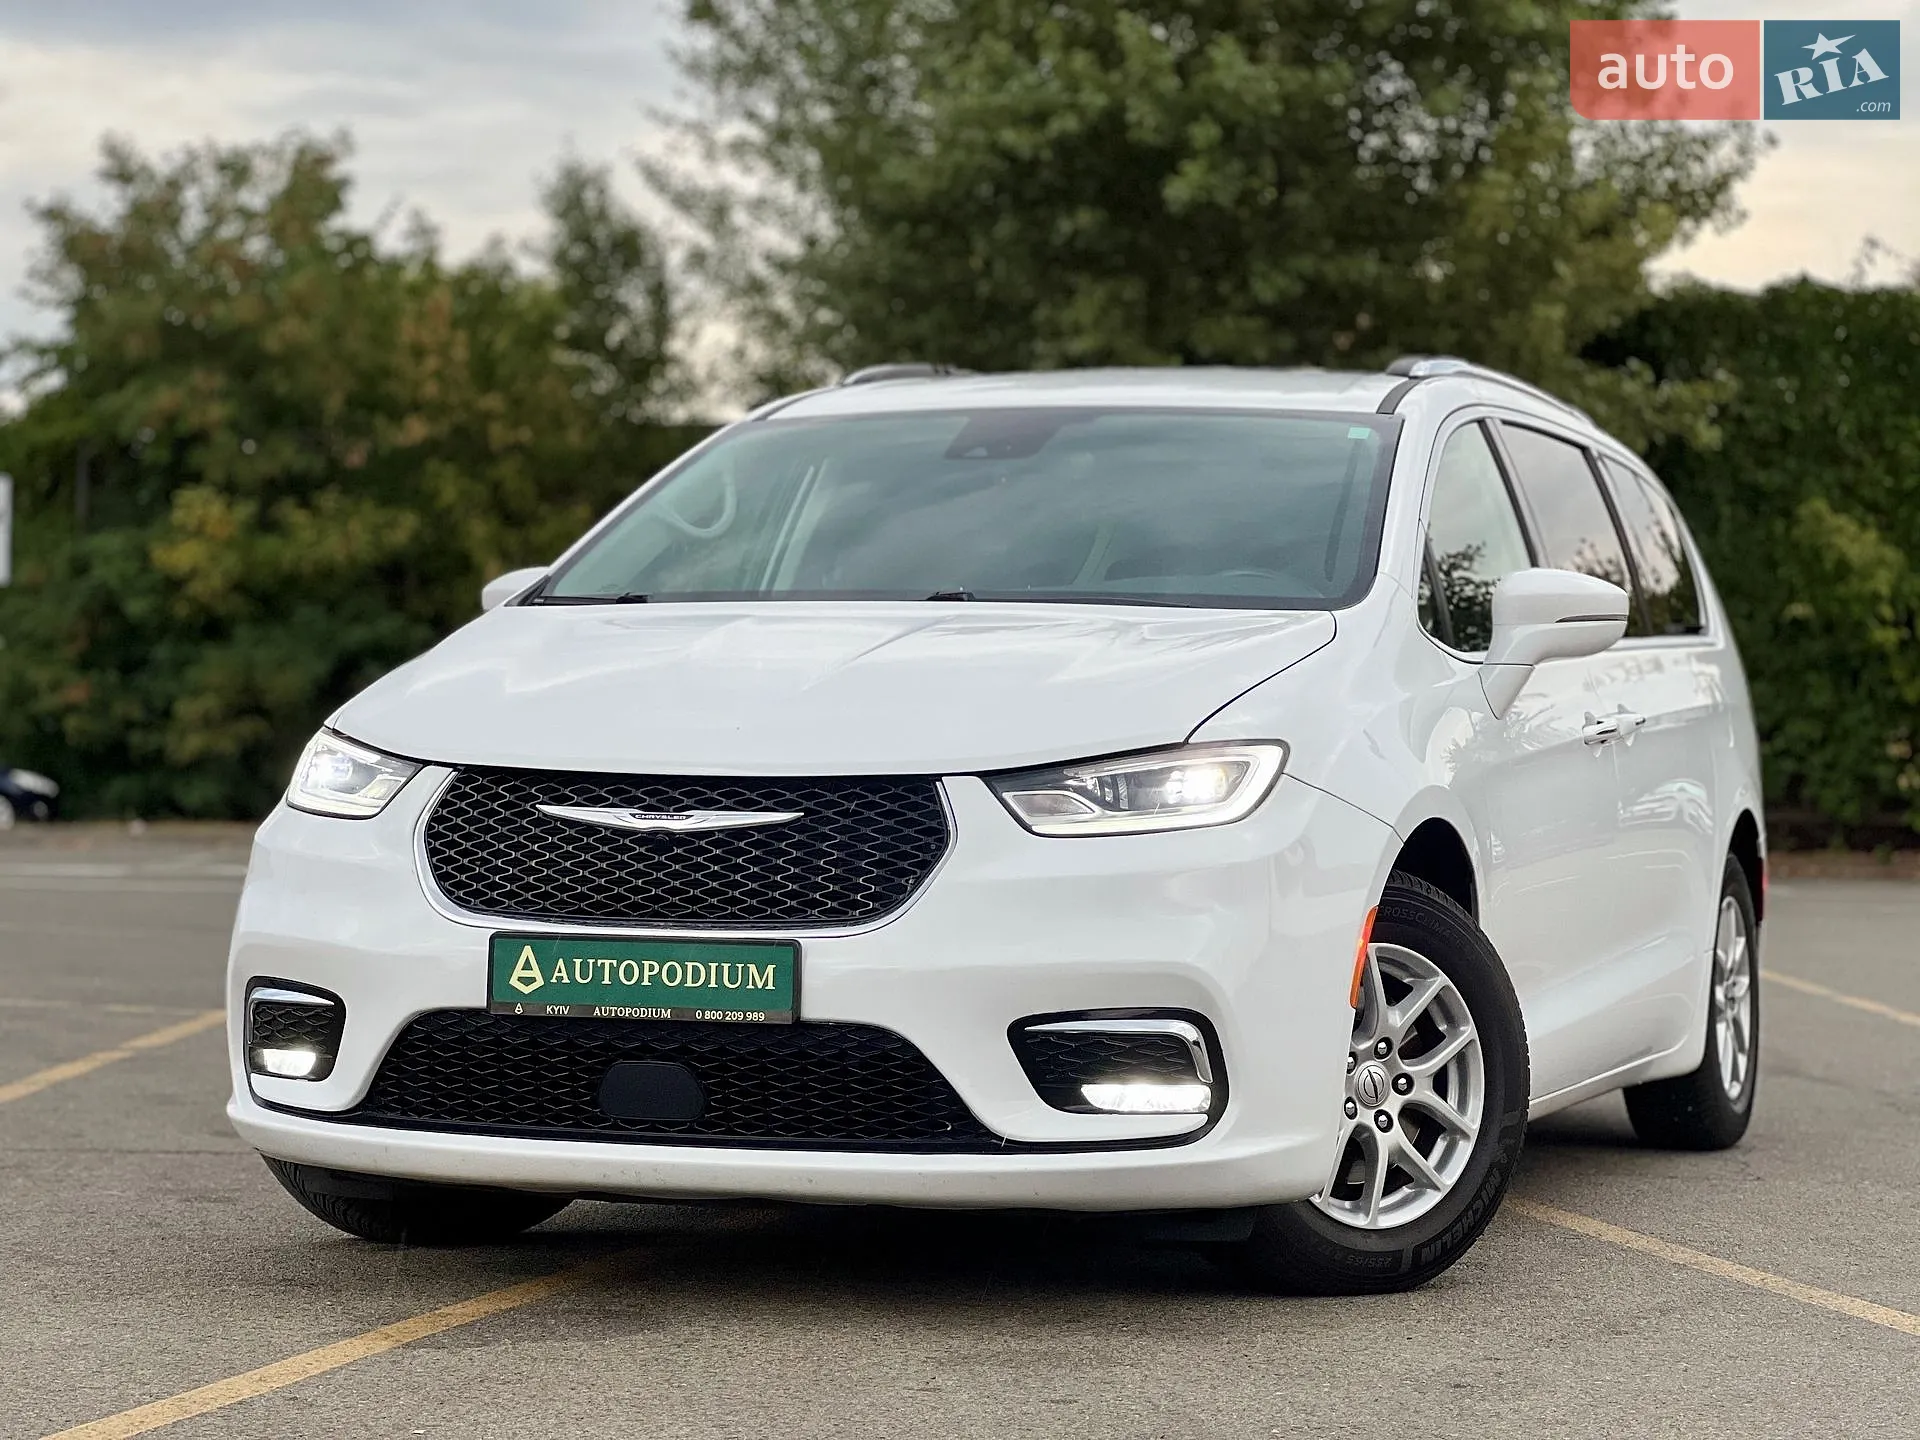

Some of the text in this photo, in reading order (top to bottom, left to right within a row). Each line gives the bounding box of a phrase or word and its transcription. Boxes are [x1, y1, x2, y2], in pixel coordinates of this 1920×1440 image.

[550, 958, 776, 990] AUTOPODIUM
[546, 1005, 765, 1022] KYIV AUTOPODIUM 0 800 209 989
[1420, 1167, 1503, 1264] MICHELIN
